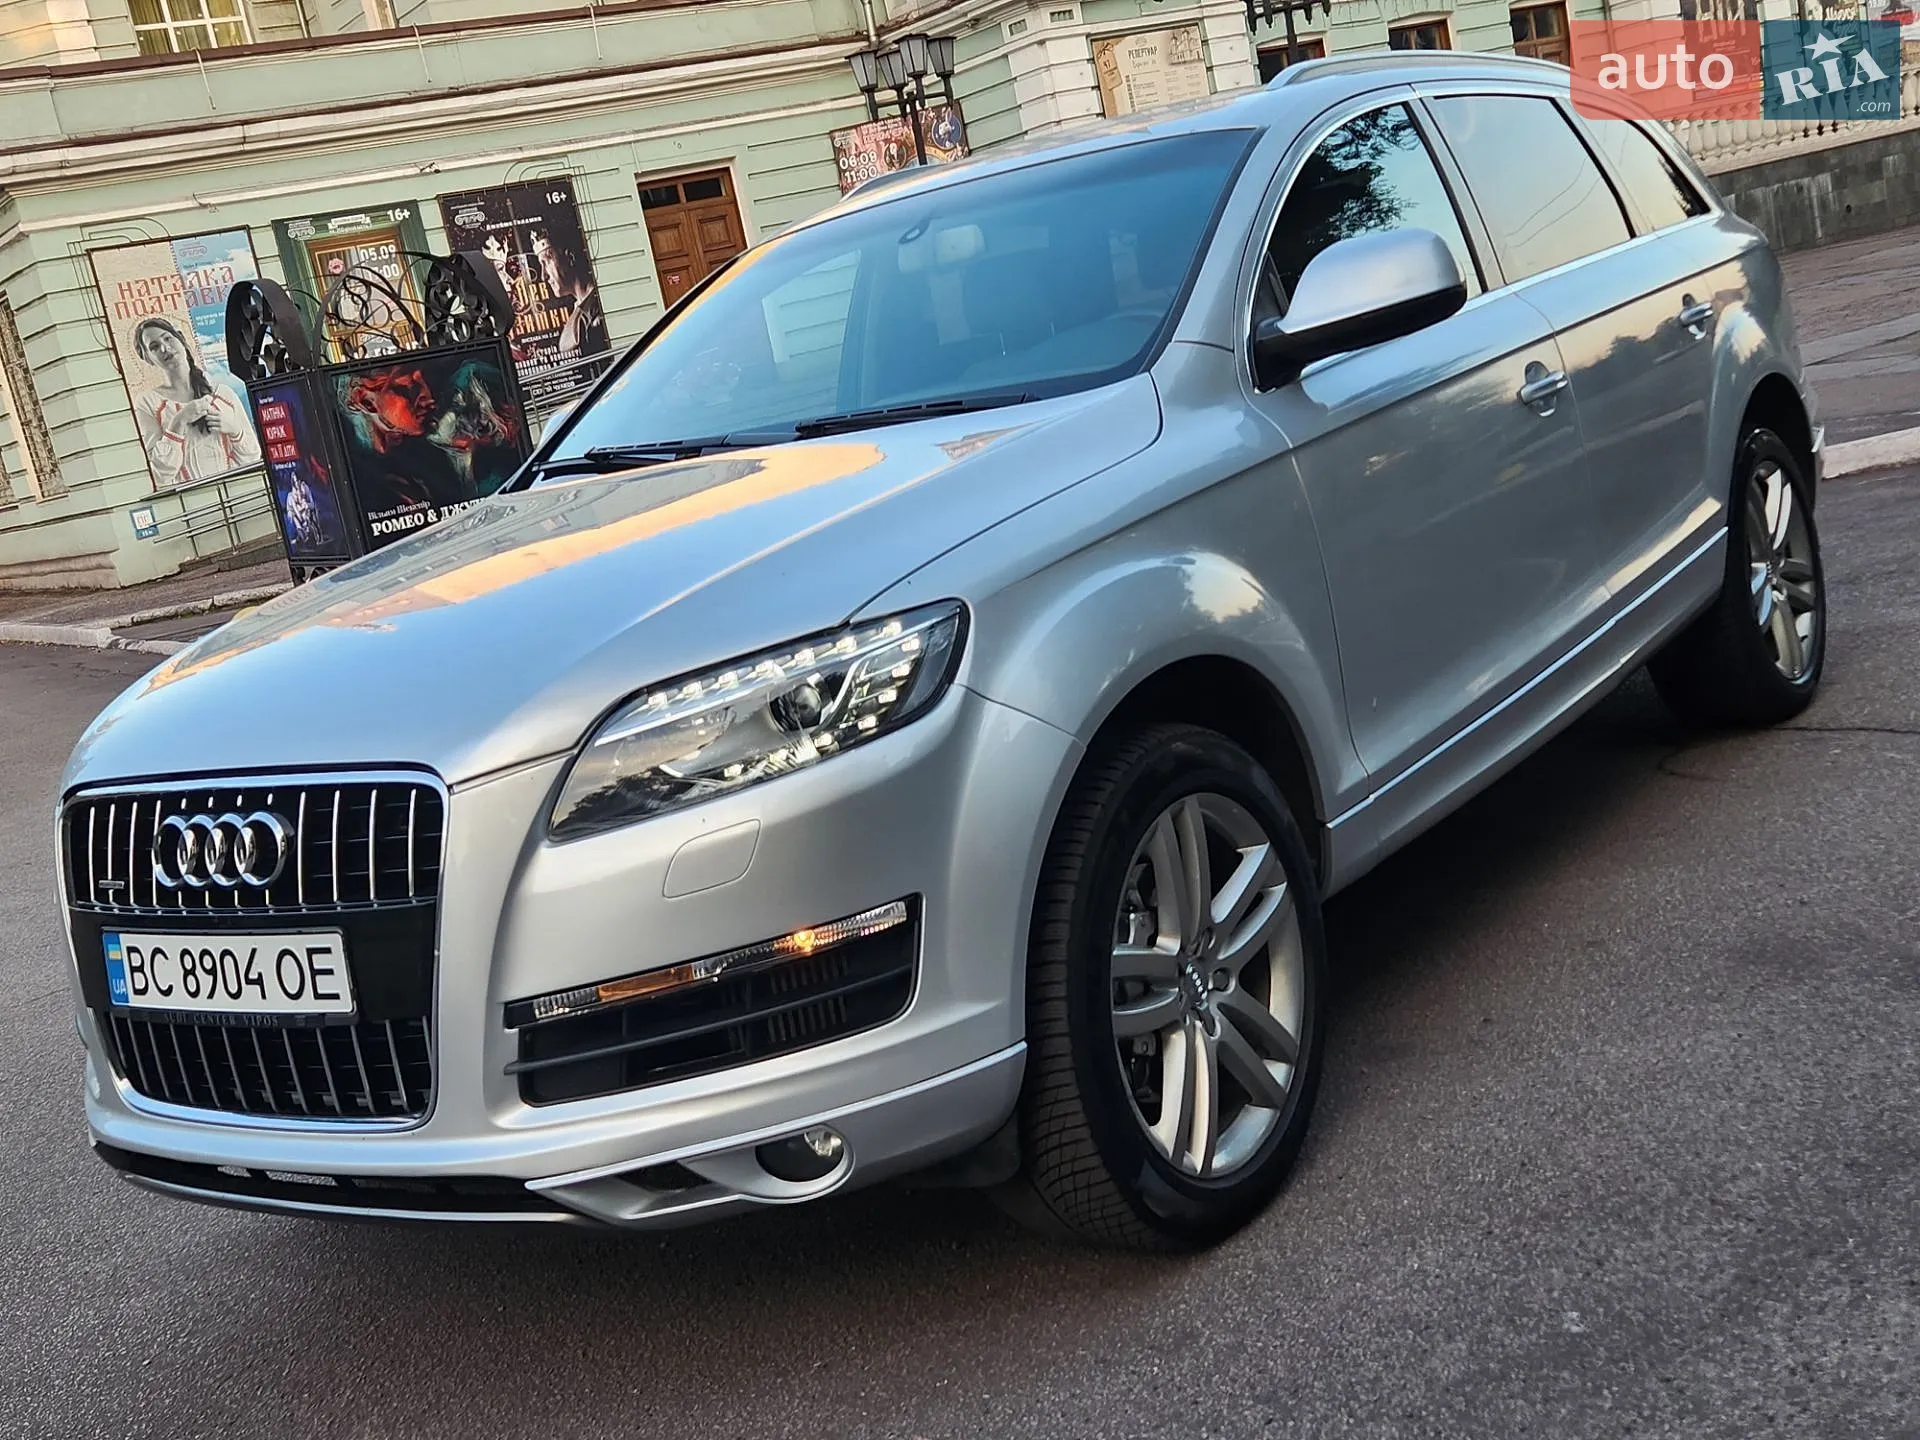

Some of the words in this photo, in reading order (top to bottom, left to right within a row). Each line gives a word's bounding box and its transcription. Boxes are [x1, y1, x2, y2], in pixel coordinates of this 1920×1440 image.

[844, 166, 877, 183] 11:00
[546, 191, 567, 205] 16+
[387, 208, 411, 221] 16+
[360, 244, 397, 261] 05.09
[371, 512, 424, 537] РОМЕО
[427, 508, 439, 523] &
[179, 947, 267, 1000] 8904
[112, 978, 128, 995] UA
